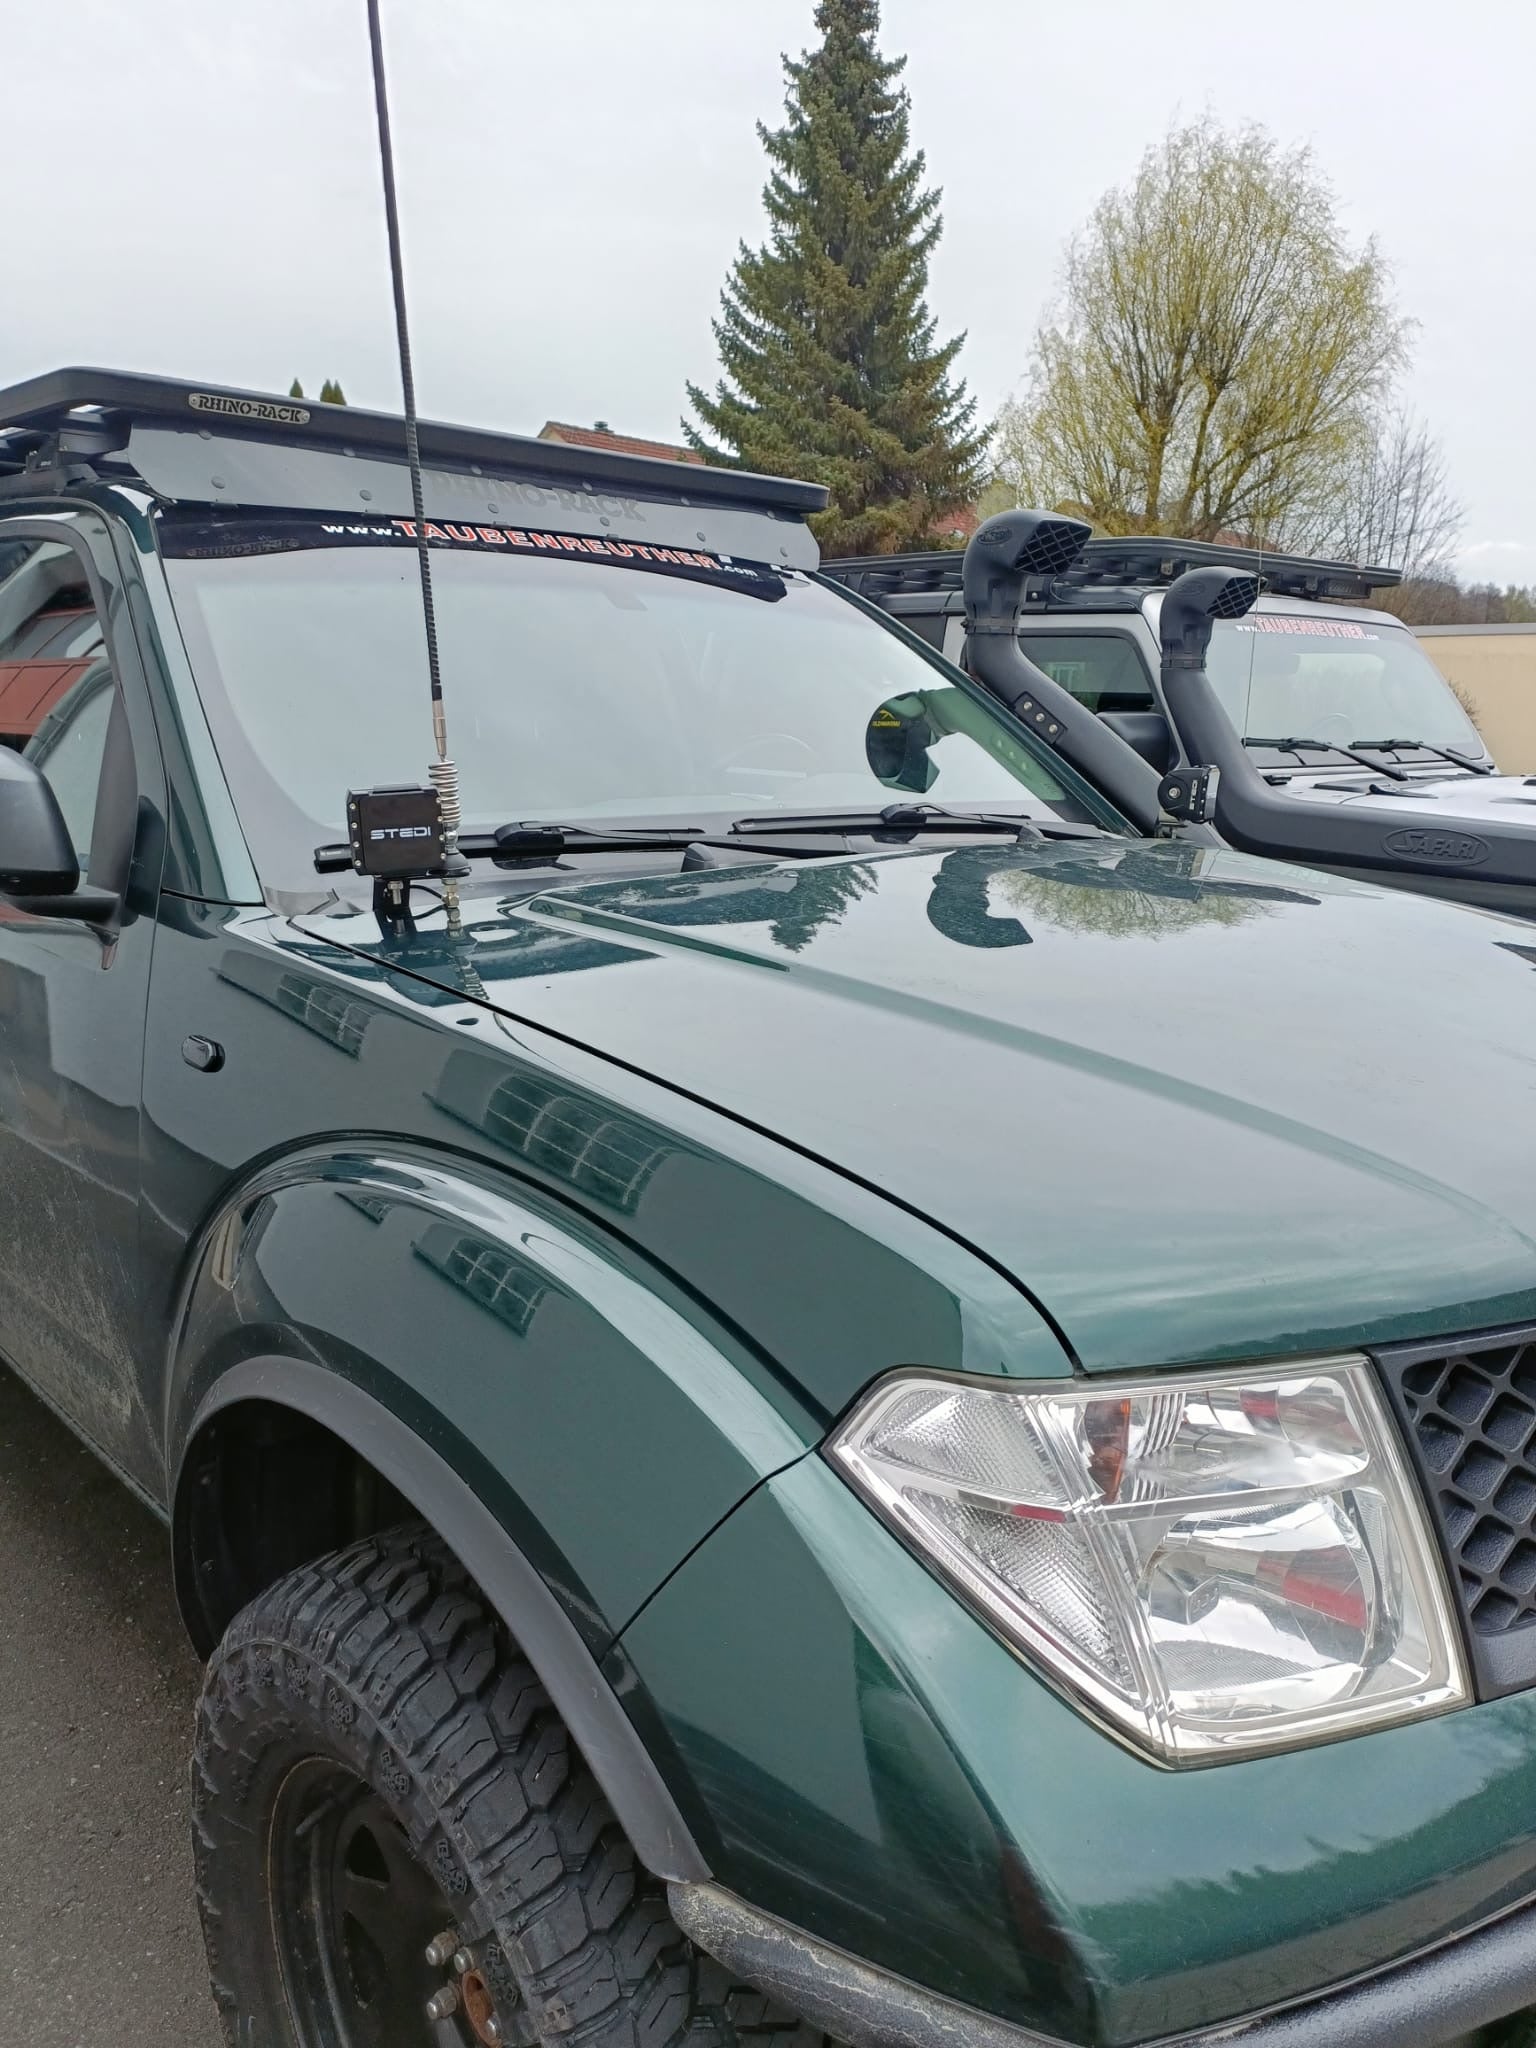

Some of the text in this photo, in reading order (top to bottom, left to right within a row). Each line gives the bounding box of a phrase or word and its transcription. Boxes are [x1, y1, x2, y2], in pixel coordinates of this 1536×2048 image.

[198, 395, 301, 422] RHINO-RACK
[432, 473, 646, 522] RHINO-RACK
[321, 519, 759, 577] www.TAUBENREUTHER.com
[370, 826, 431, 840] STEDI
[1393, 830, 1480, 859] SAFARI
